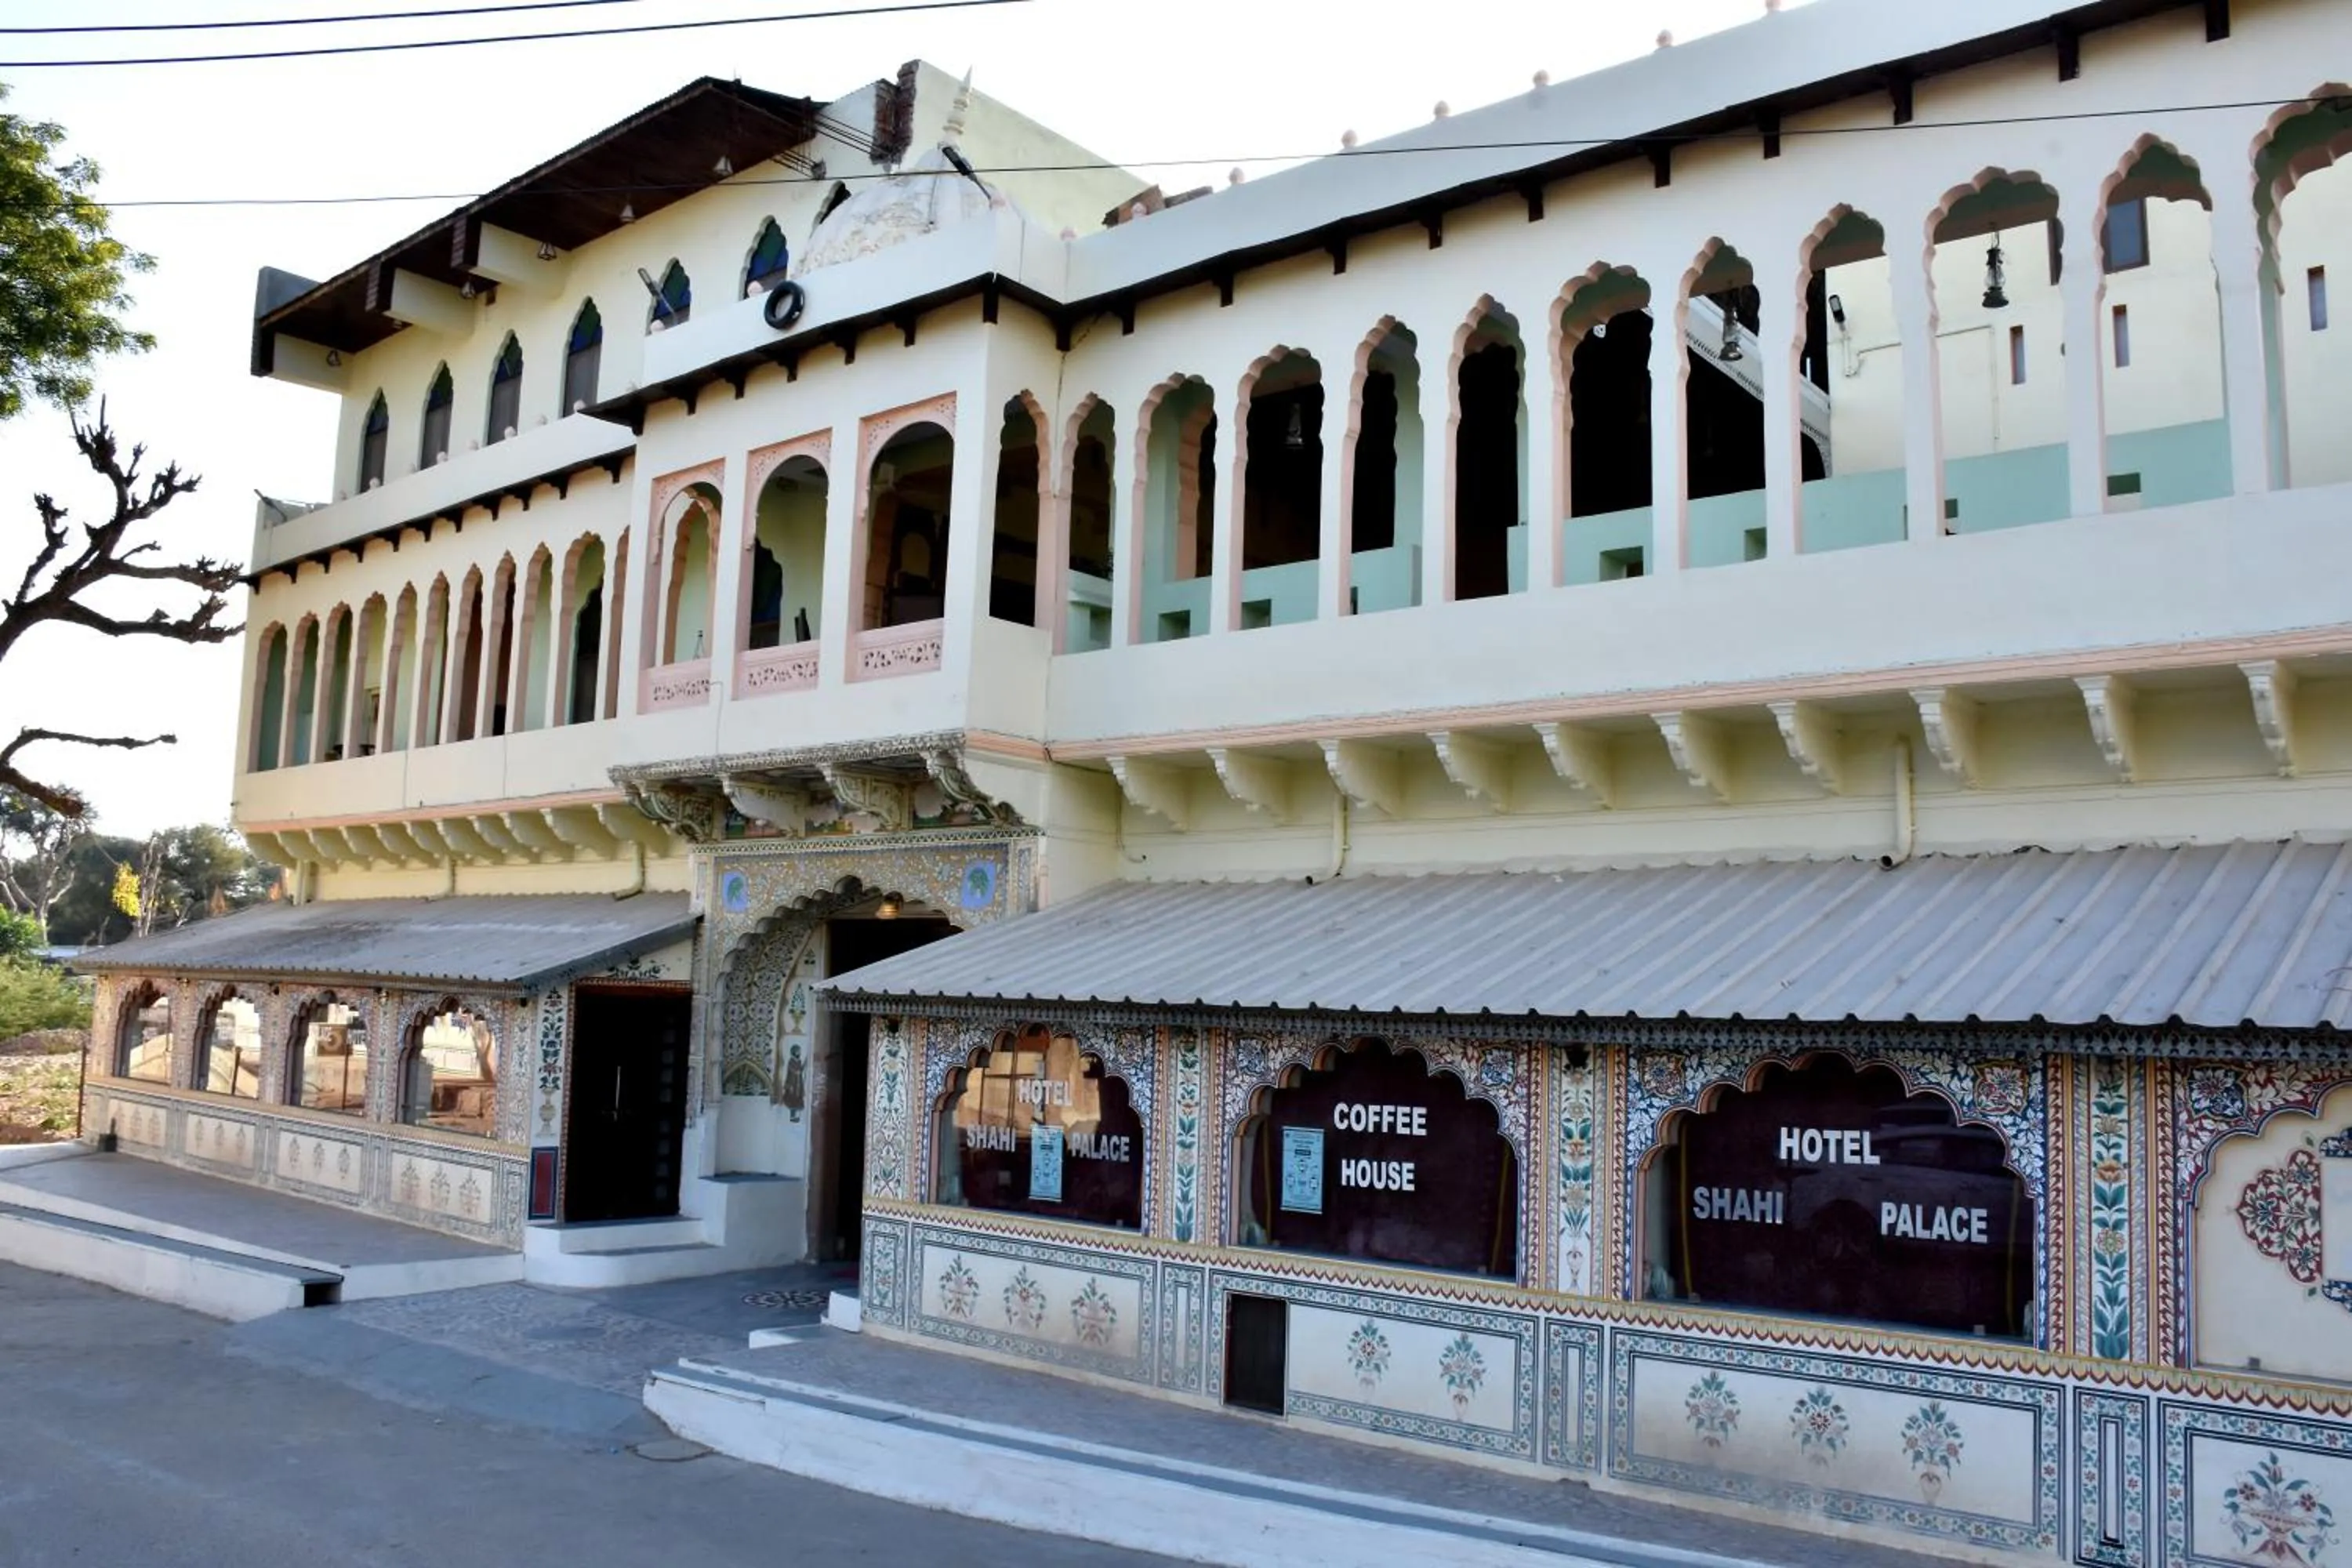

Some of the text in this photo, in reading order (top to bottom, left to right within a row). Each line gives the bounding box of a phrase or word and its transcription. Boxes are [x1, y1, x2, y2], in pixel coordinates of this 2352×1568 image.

[1018, 1078, 1073, 1106] HOTEL
[1334, 1102, 1428, 1136] COFFEE
[966, 1123, 1130, 1163] SHAHI PALACE
[1779, 1127, 1881, 1165] HOTEL
[1341, 1159, 1415, 1192] HOUSE
[1693, 1186, 1988, 1243] SHAHI PALACE
